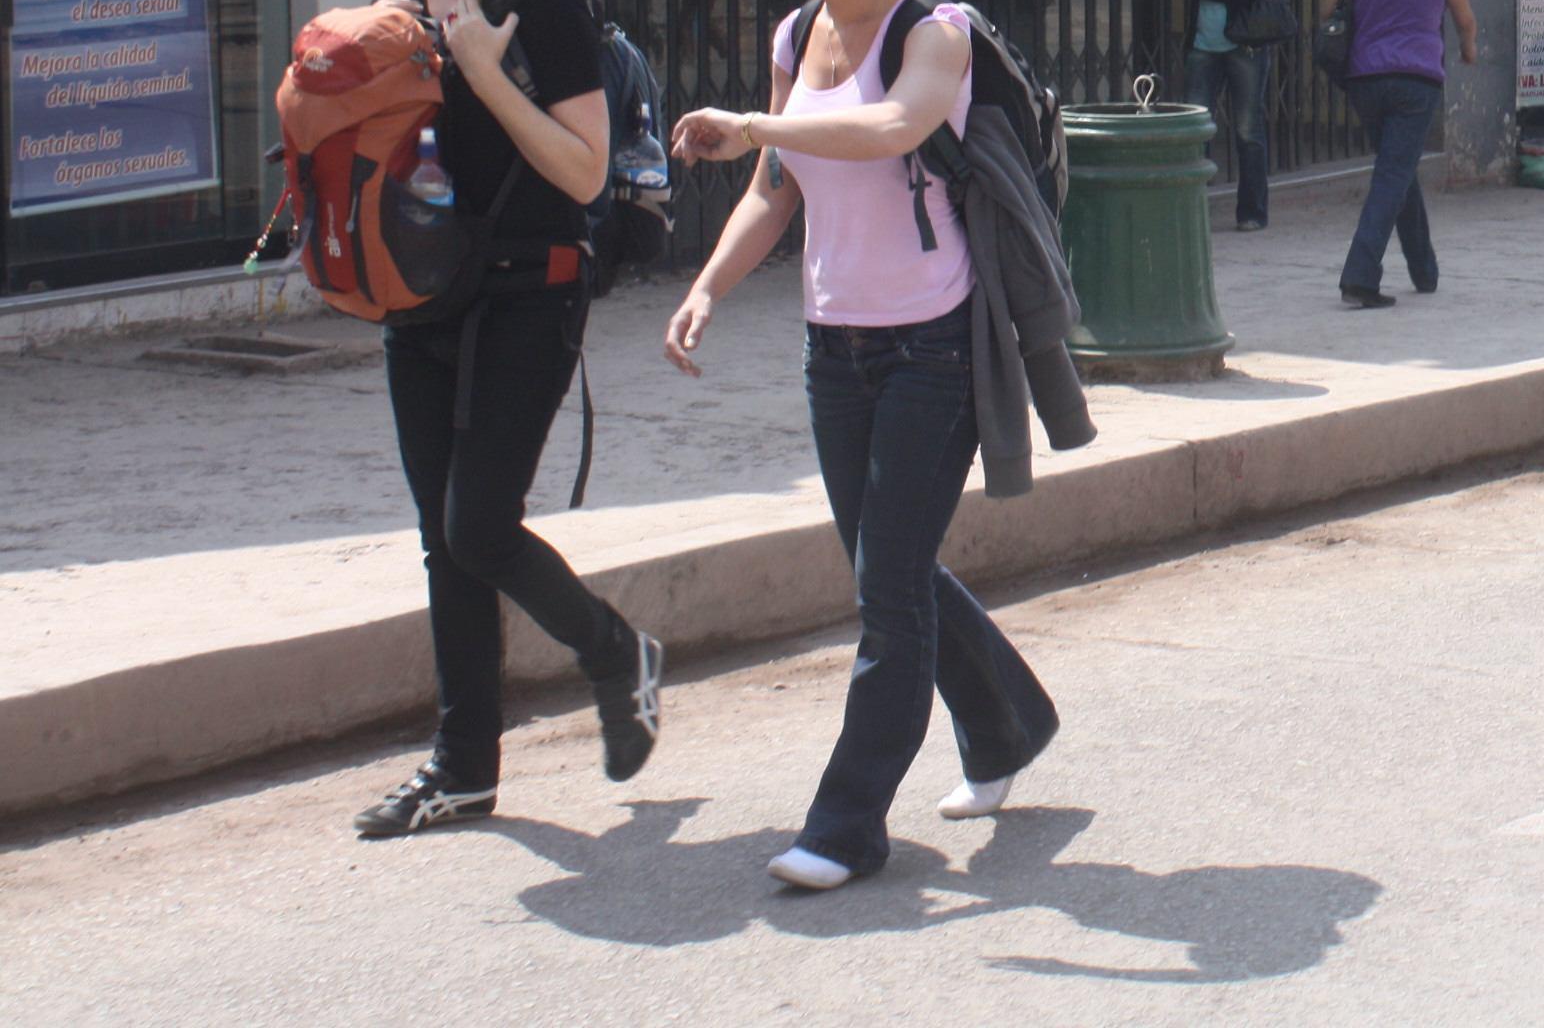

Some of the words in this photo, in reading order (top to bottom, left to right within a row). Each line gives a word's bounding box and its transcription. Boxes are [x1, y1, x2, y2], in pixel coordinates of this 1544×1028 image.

[72, 0, 85, 21] el
[21, 54, 82, 80] Mejora
[86, 49, 100, 71] la
[103, 41, 158, 67] calidad
[46, 82, 74, 108] del
[1518, 75, 1538, 89] VA:
[18, 130, 97, 161] Fortalece
[99, 126, 122, 150] los
